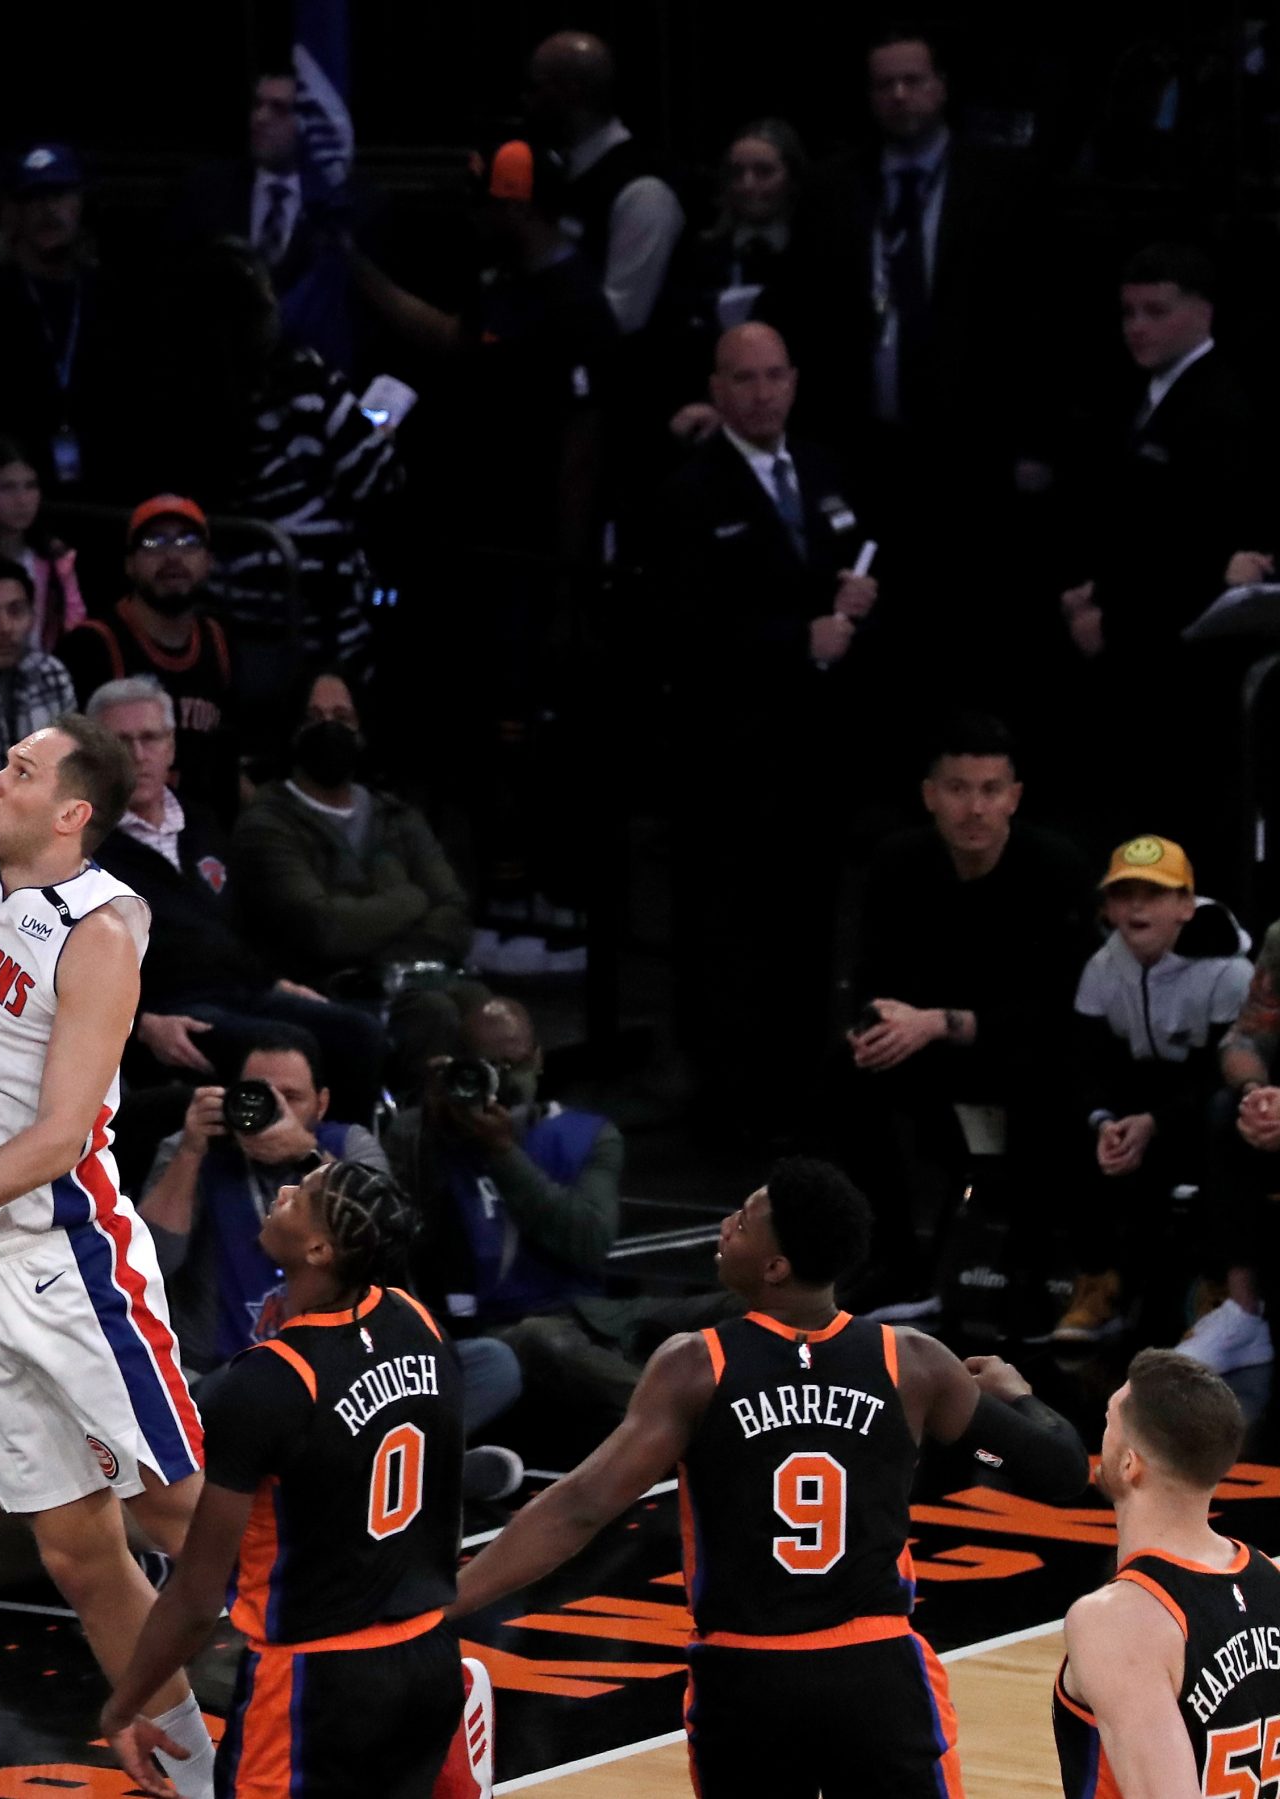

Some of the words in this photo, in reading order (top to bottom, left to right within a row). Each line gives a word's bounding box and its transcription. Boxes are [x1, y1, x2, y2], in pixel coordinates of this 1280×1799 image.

[21, 914, 54, 938] UWM
[333, 1354, 440, 1437] REDDISH
[730, 1383, 886, 1440] BARRETT
[366, 1421, 426, 1541] 0
[772, 1451, 848, 1575] 9
[1186, 1626, 1280, 1725] HARTENS
[1200, 1714, 1280, 1799] 5
